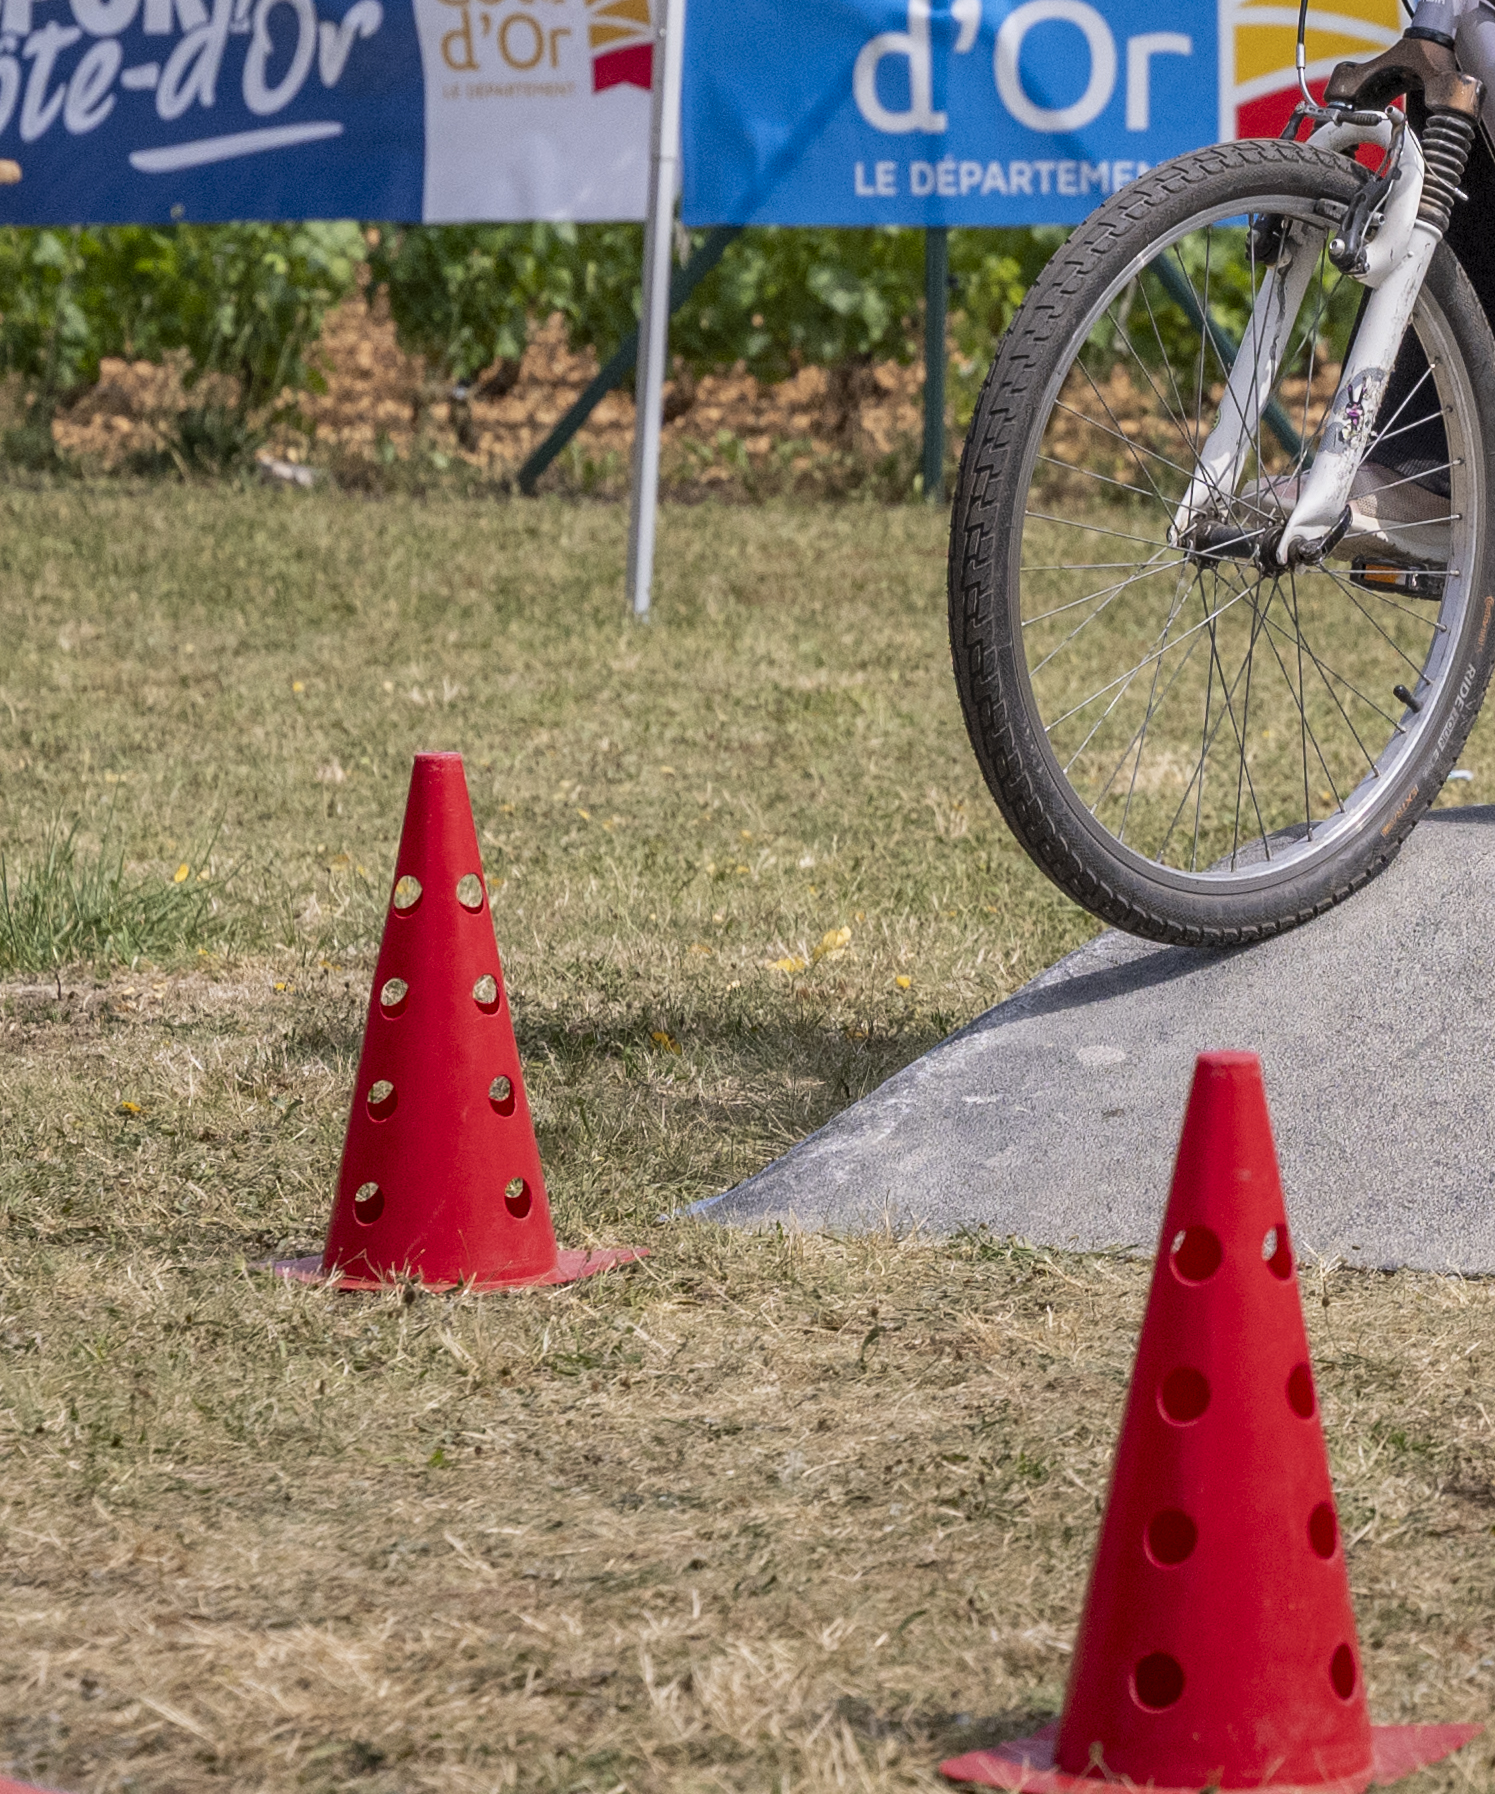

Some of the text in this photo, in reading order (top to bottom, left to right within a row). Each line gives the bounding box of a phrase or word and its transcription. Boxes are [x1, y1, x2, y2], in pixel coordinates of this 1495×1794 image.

[440, 5, 572, 73] d'Or
[853, 160, 898, 197] LE
[1454, 662, 1477, 713] RIDE
